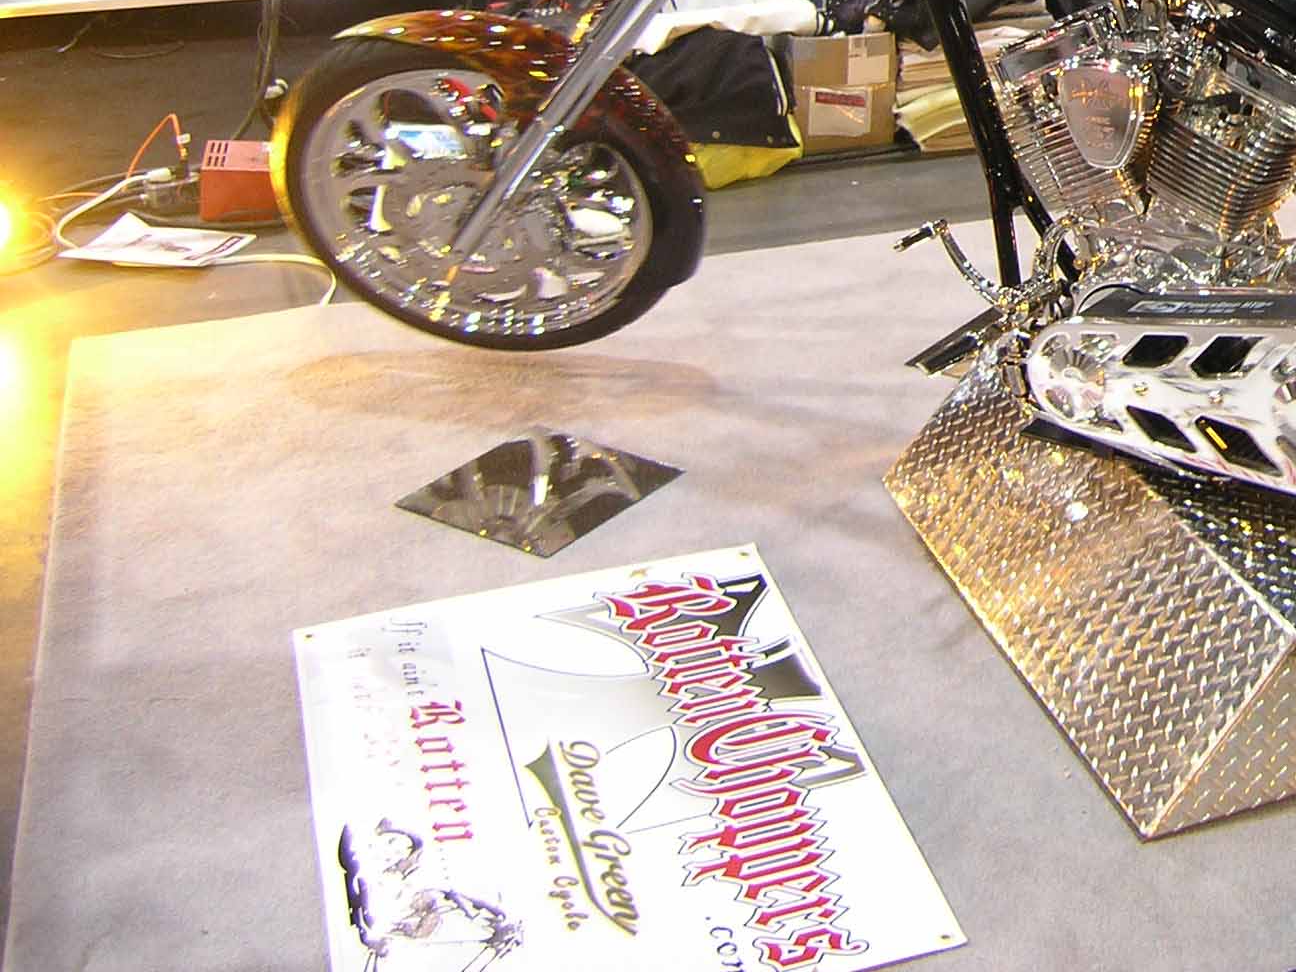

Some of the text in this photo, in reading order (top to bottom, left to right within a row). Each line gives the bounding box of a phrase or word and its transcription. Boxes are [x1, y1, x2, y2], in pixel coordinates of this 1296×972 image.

[560, 740, 640, 935] Dave Green
[595, 574, 868, 970] Rotten Choppers
